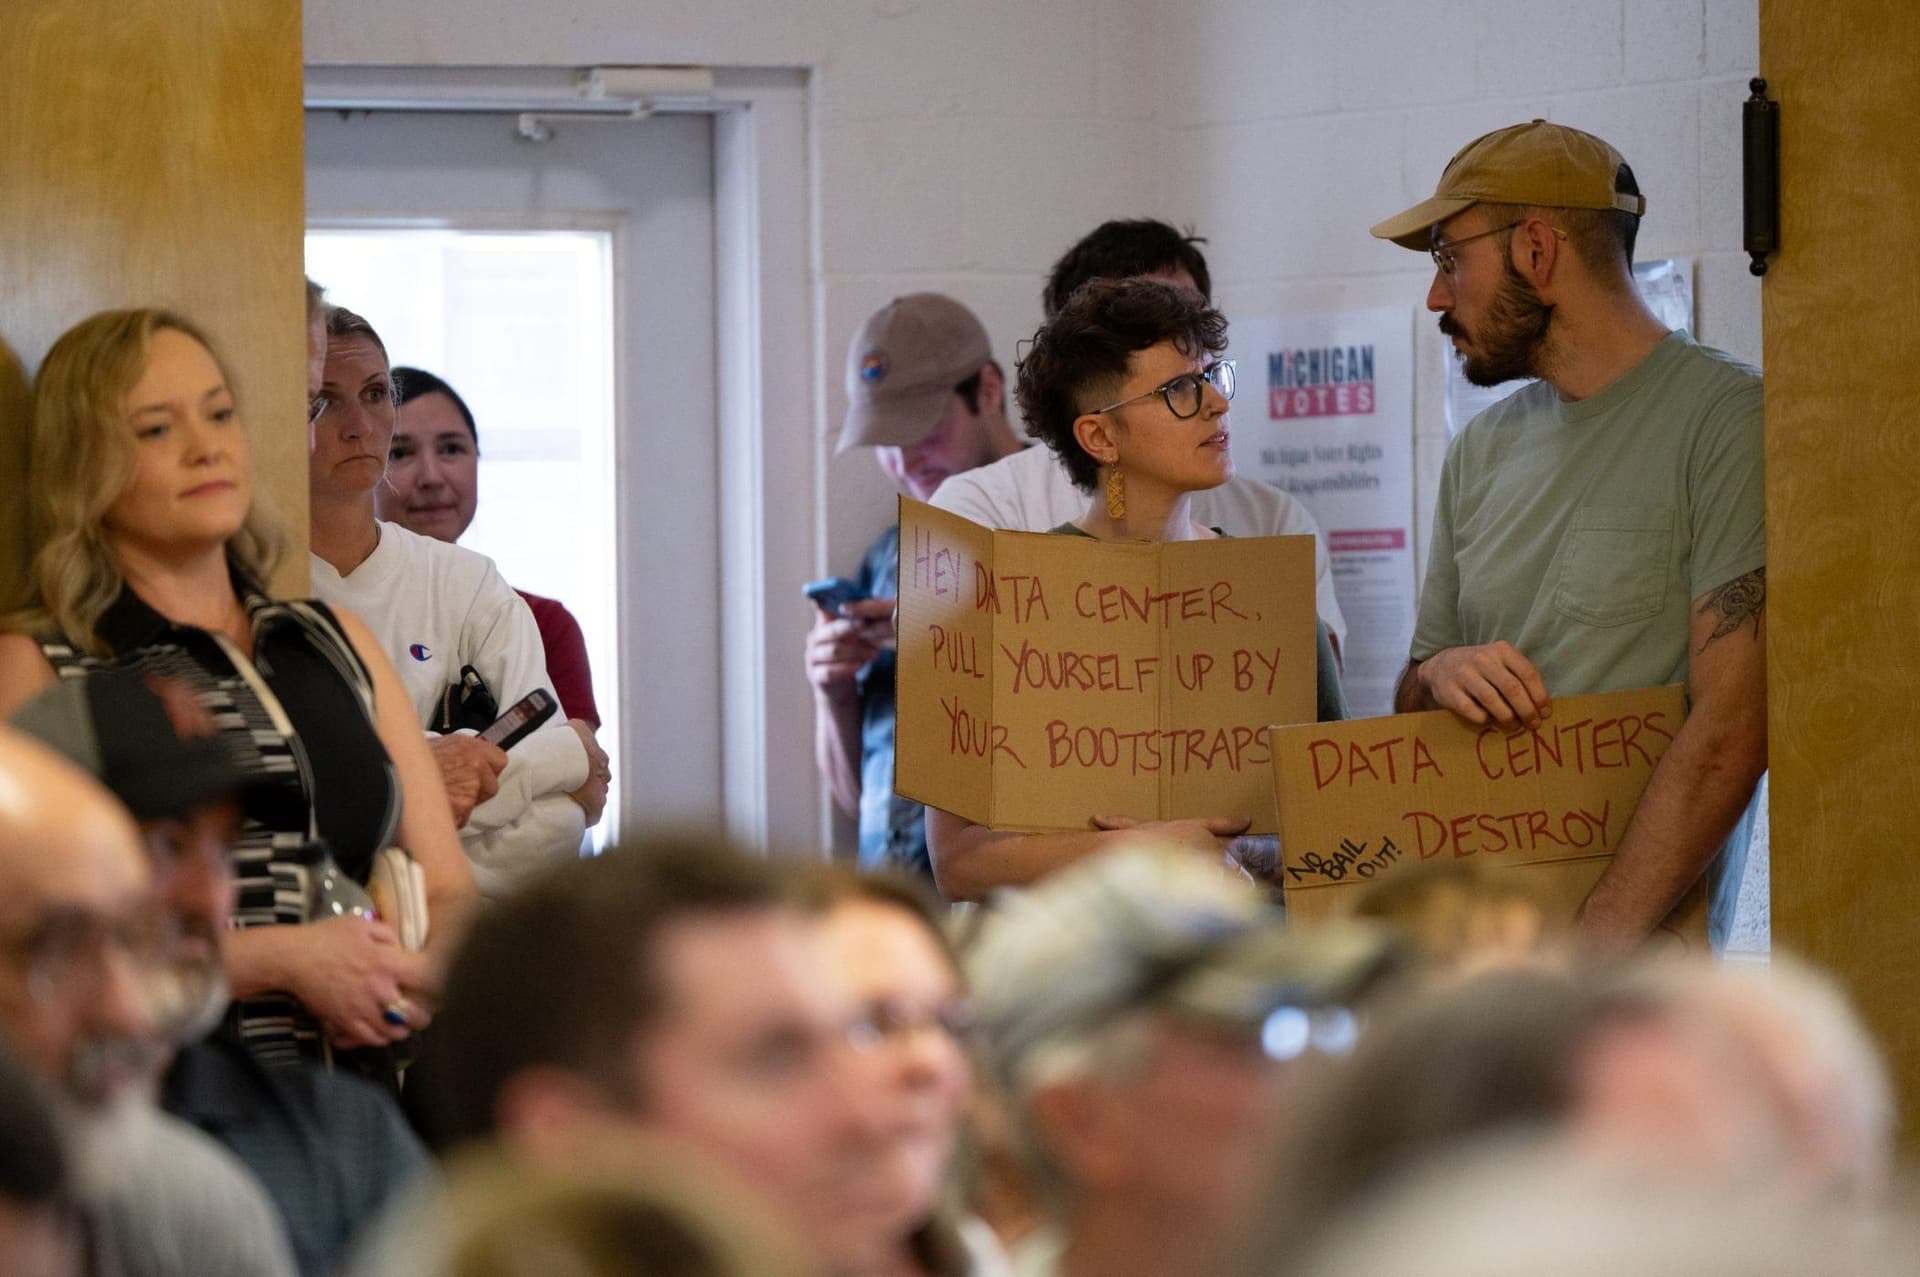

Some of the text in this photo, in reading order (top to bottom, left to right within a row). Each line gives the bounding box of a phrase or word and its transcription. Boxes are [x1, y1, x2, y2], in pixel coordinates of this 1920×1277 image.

[1271, 386, 1371, 417] VOTES
[914, 525, 1262, 629] HEY DATA CENTER,
[928, 624, 1281, 695] PULL YOURSELF UP BY
[941, 696, 1271, 776] YOUR BOOTSTRAPS
[1308, 711, 1674, 791] DATA CENTERS
[1287, 837, 1368, 882] NO BAIL
[1356, 835, 1403, 879] OUT!
[1402, 799, 1611, 861] DESTROY
